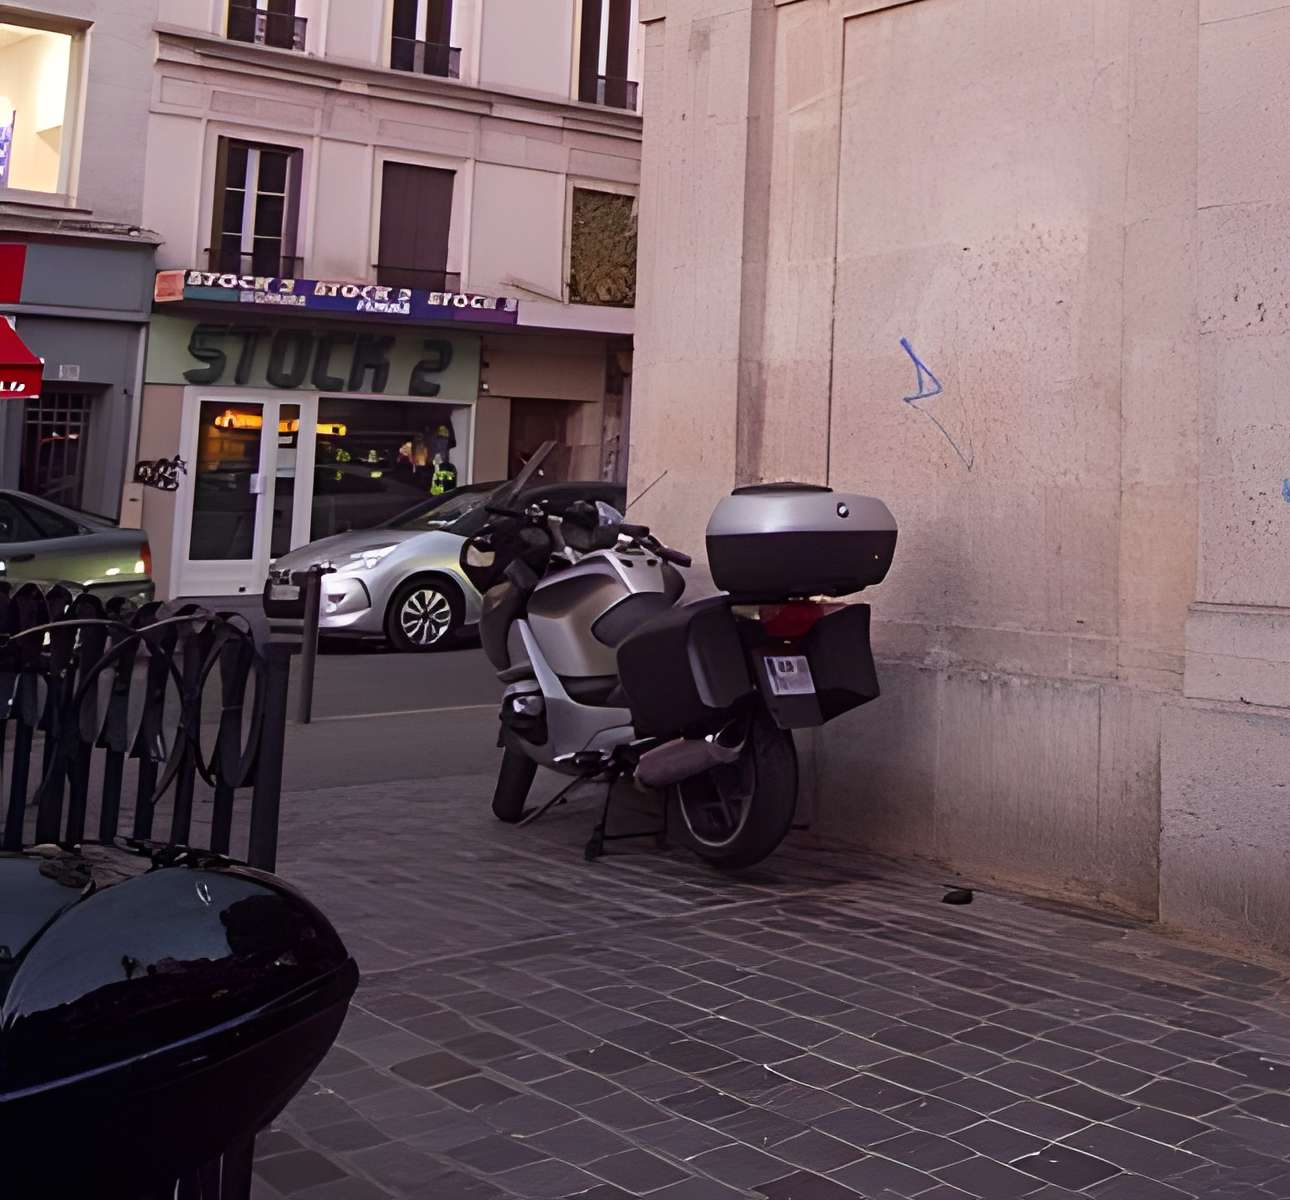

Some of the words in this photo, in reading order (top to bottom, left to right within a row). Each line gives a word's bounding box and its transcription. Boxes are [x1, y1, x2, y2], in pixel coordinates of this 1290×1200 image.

[187, 271, 274, 292] STOCK
[314, 281, 393, 301] STOCK
[182, 323, 396, 392] STOCK
[408, 338, 453, 397] 2
